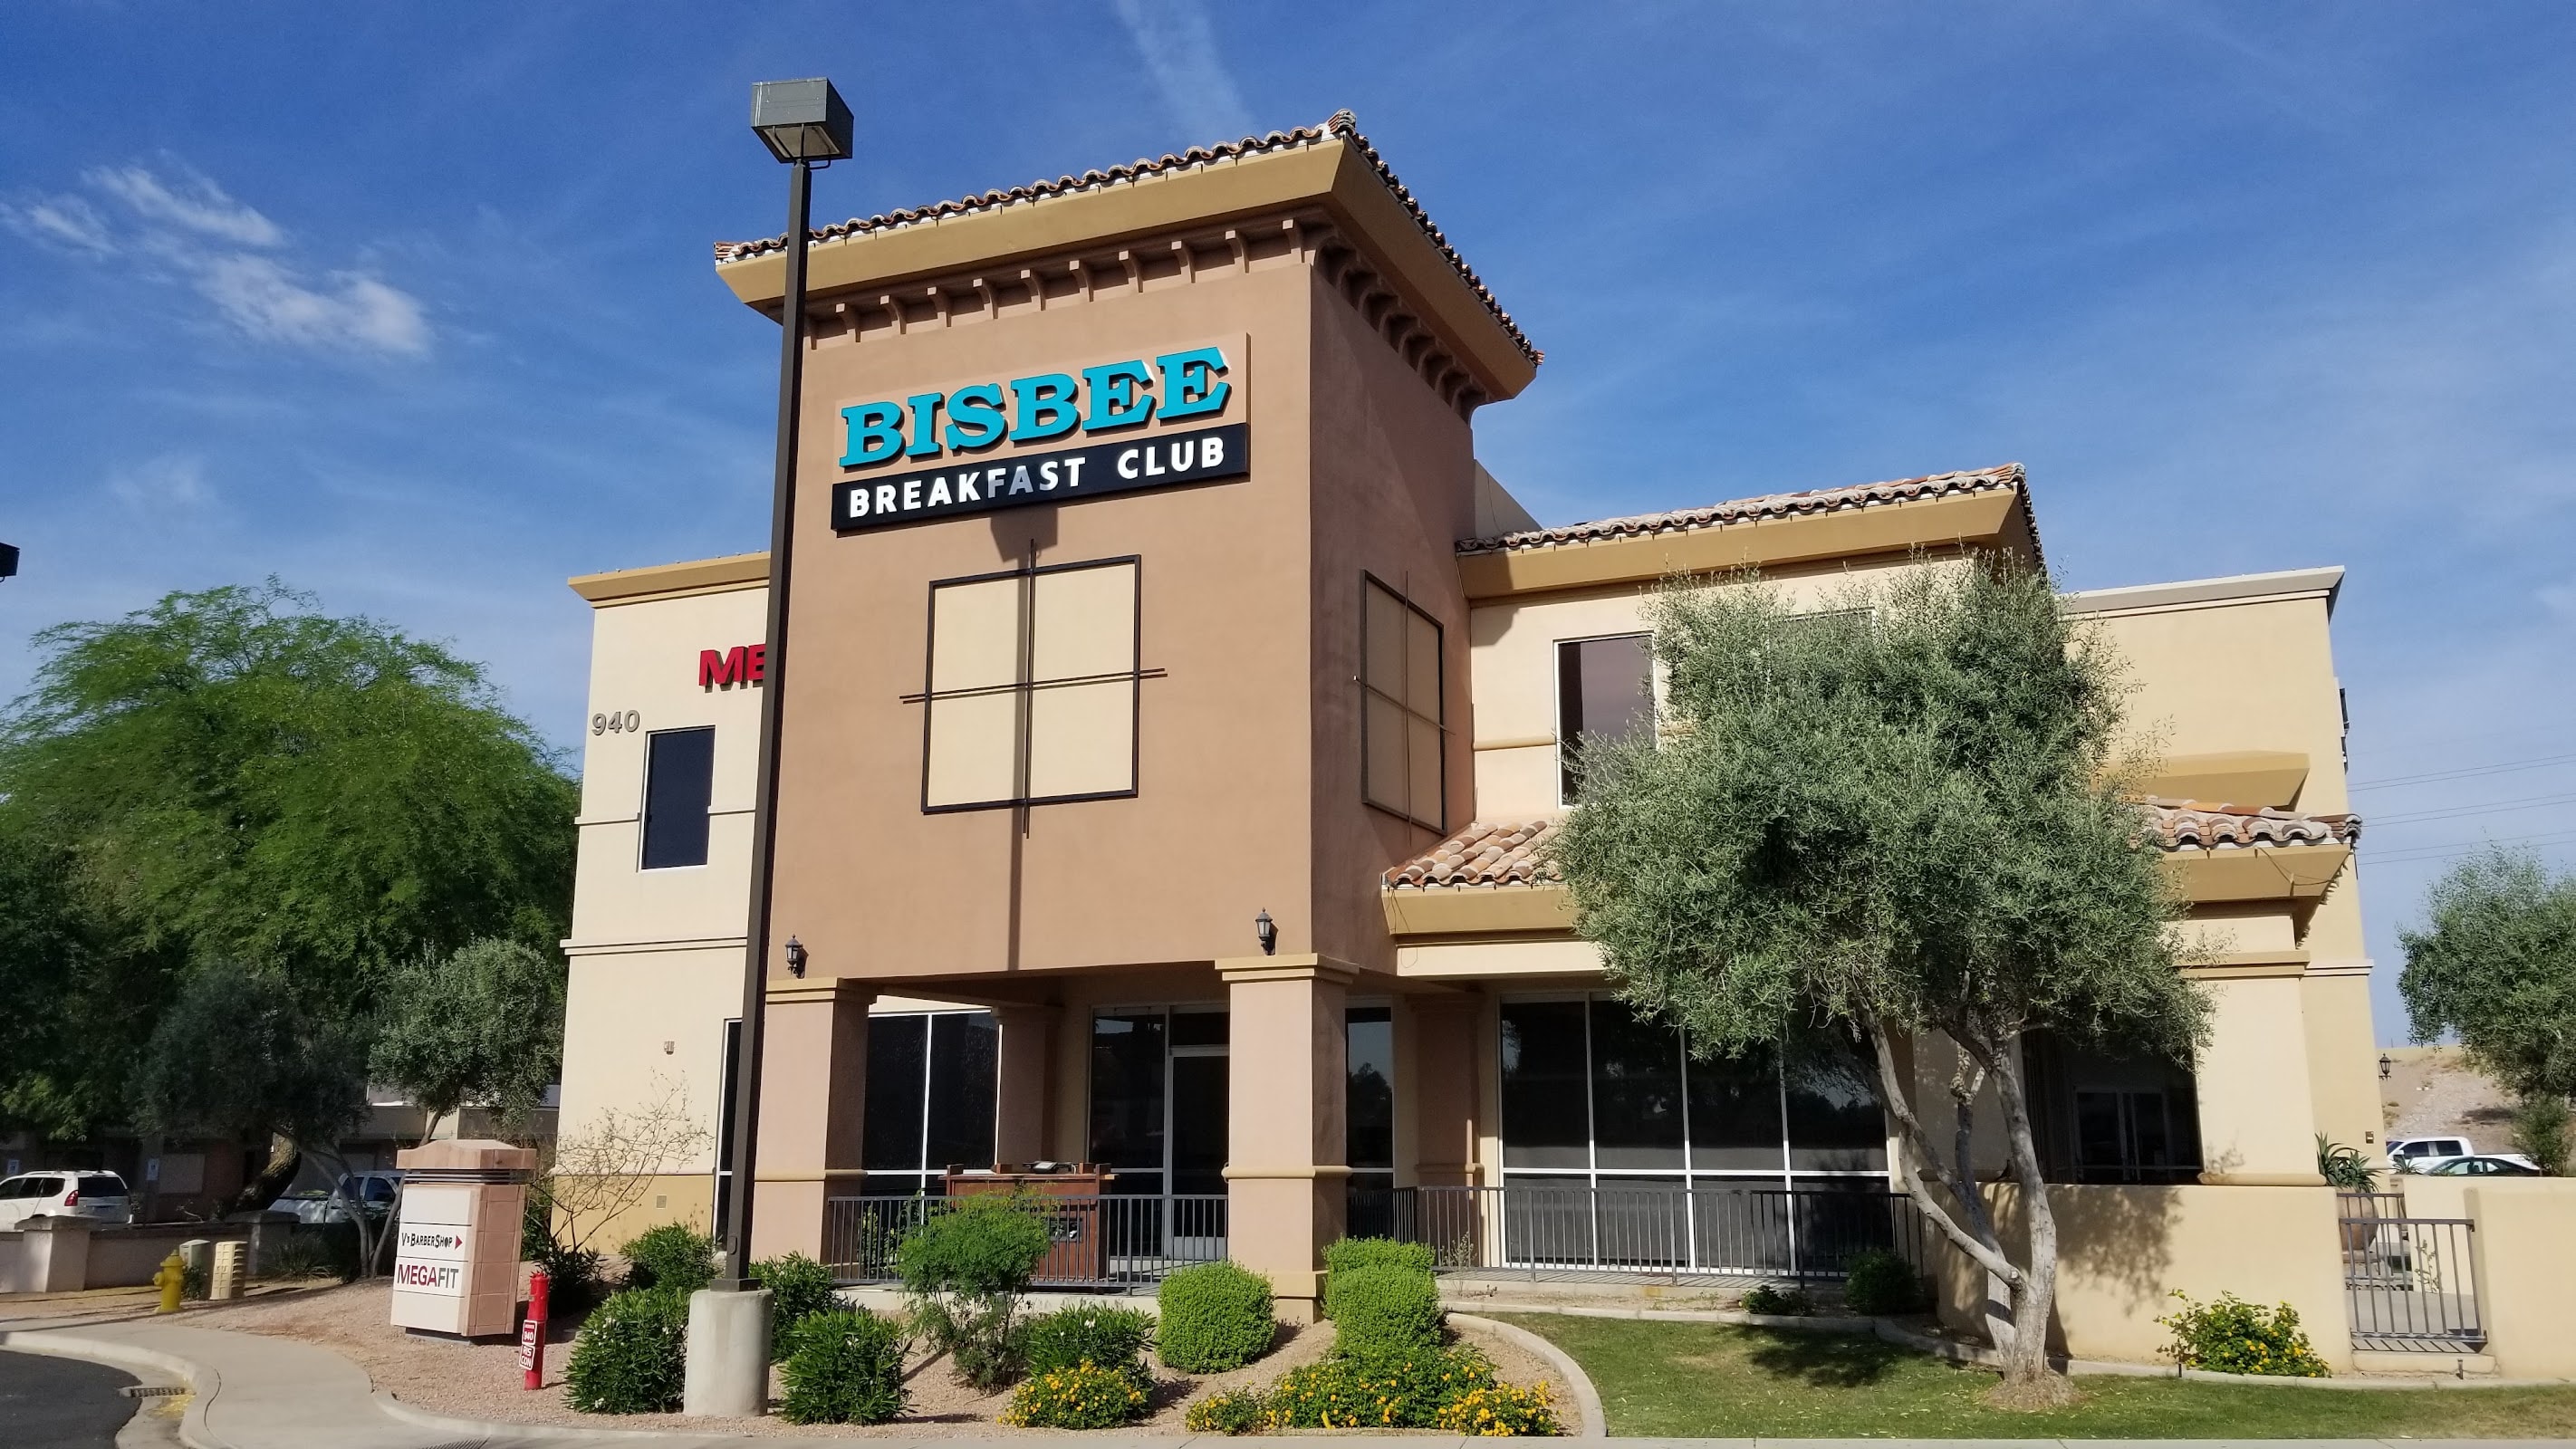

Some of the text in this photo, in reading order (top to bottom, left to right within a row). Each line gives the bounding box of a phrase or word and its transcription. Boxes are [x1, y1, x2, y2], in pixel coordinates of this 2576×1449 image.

[839, 346, 1232, 469] BISBEE
[849, 437, 1225, 519] BREAKFAST CLUB
[591, 710, 639, 735] 940
[397, 1263, 459, 1289] MEGAFIT
[524, 1331, 533, 1341] 940
